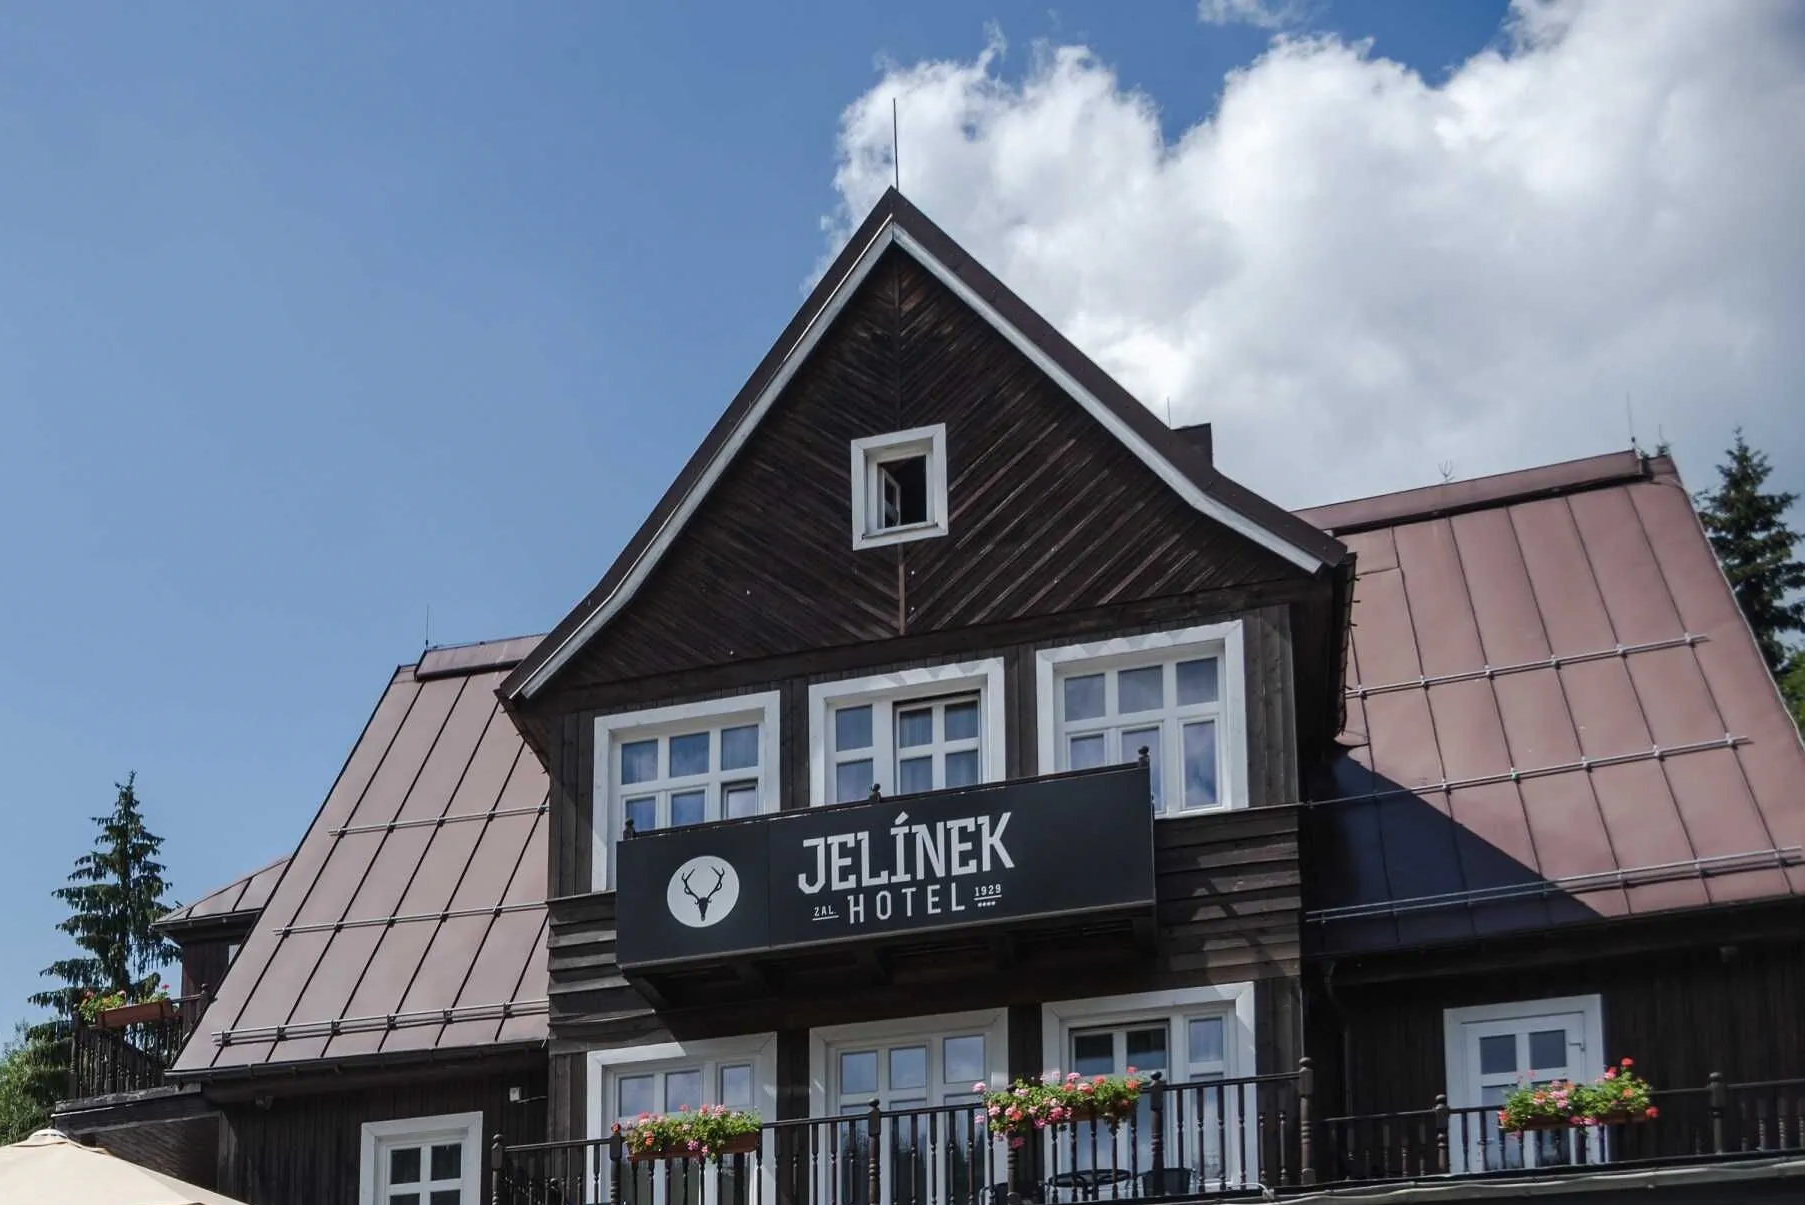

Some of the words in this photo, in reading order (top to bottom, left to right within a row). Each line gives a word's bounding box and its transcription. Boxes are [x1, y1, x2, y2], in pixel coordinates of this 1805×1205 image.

[798, 811, 1015, 895] JELÍNEK
[847, 882, 965, 925] HOTEL
[974, 883, 1002, 896] 1929
